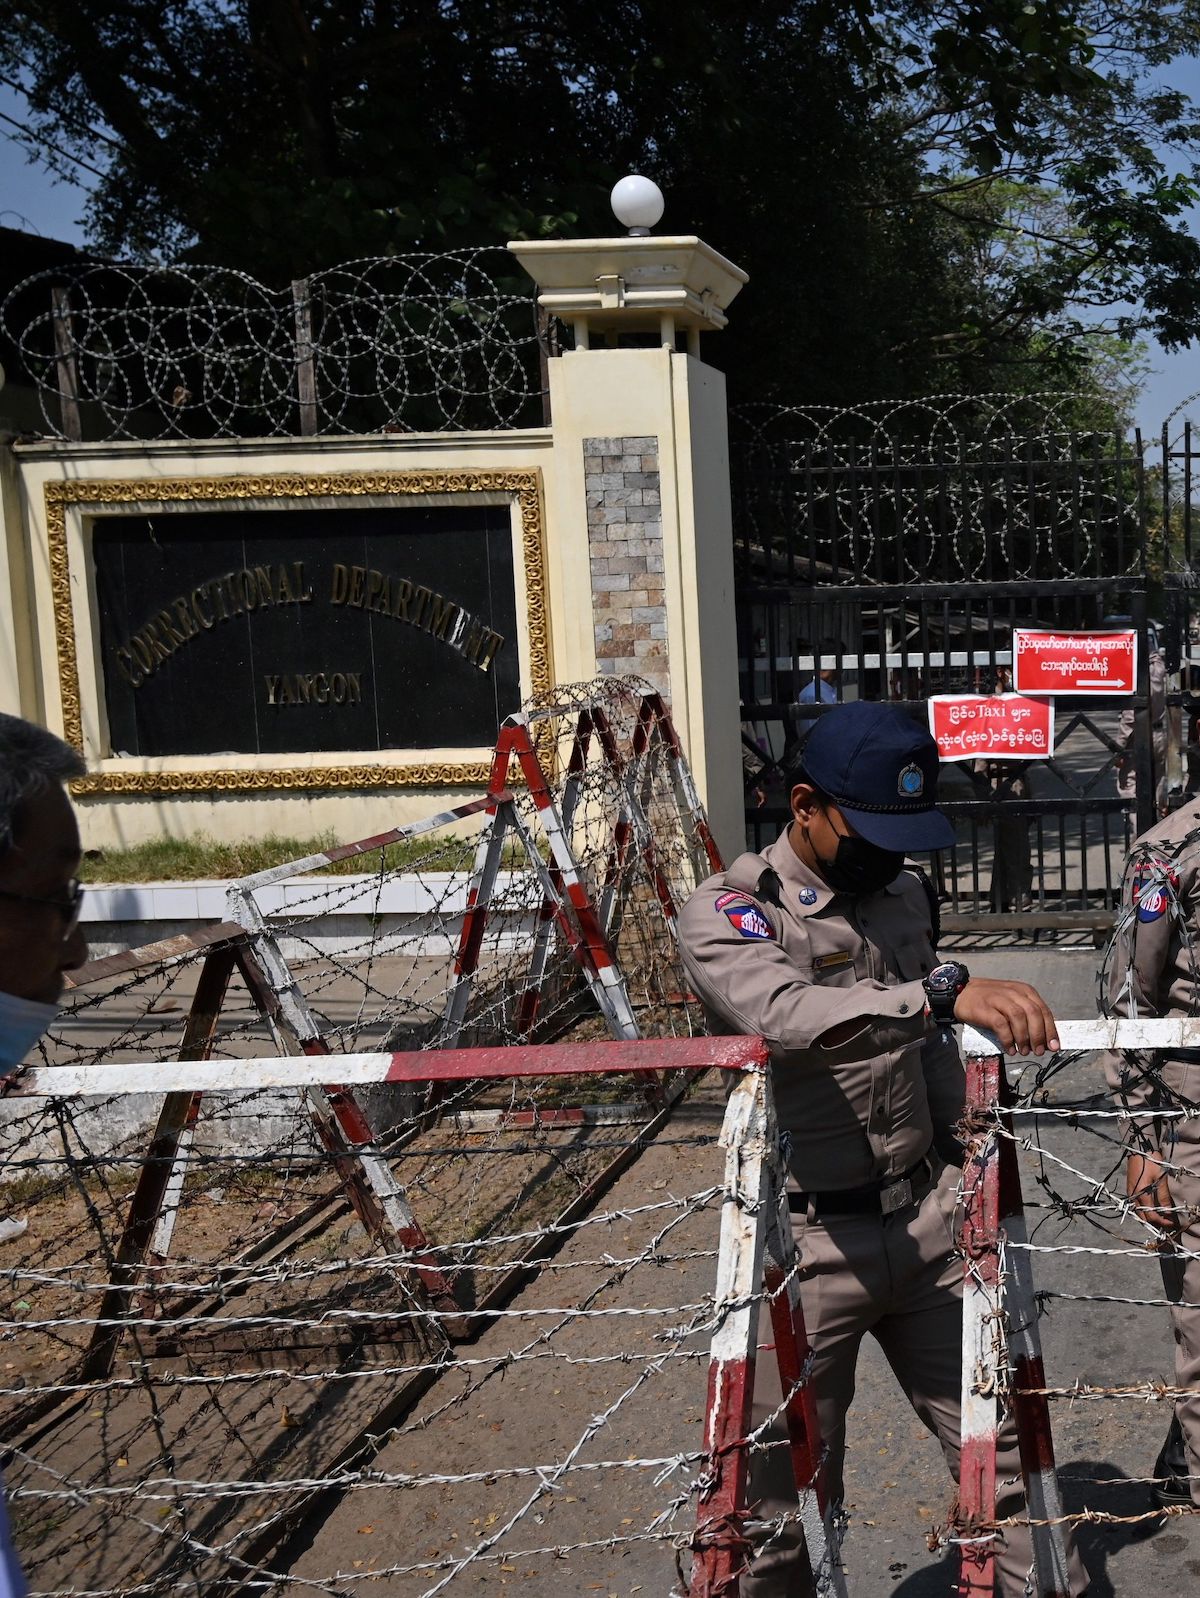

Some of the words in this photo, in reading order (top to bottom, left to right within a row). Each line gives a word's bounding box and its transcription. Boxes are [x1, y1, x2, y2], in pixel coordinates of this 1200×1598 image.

[116, 561, 312, 688] CORRECTIONAL
[329, 563, 505, 672] DEPARTMENT
[263, 672, 361, 705] YANGON
[976, 704, 1006, 718] Taxi
